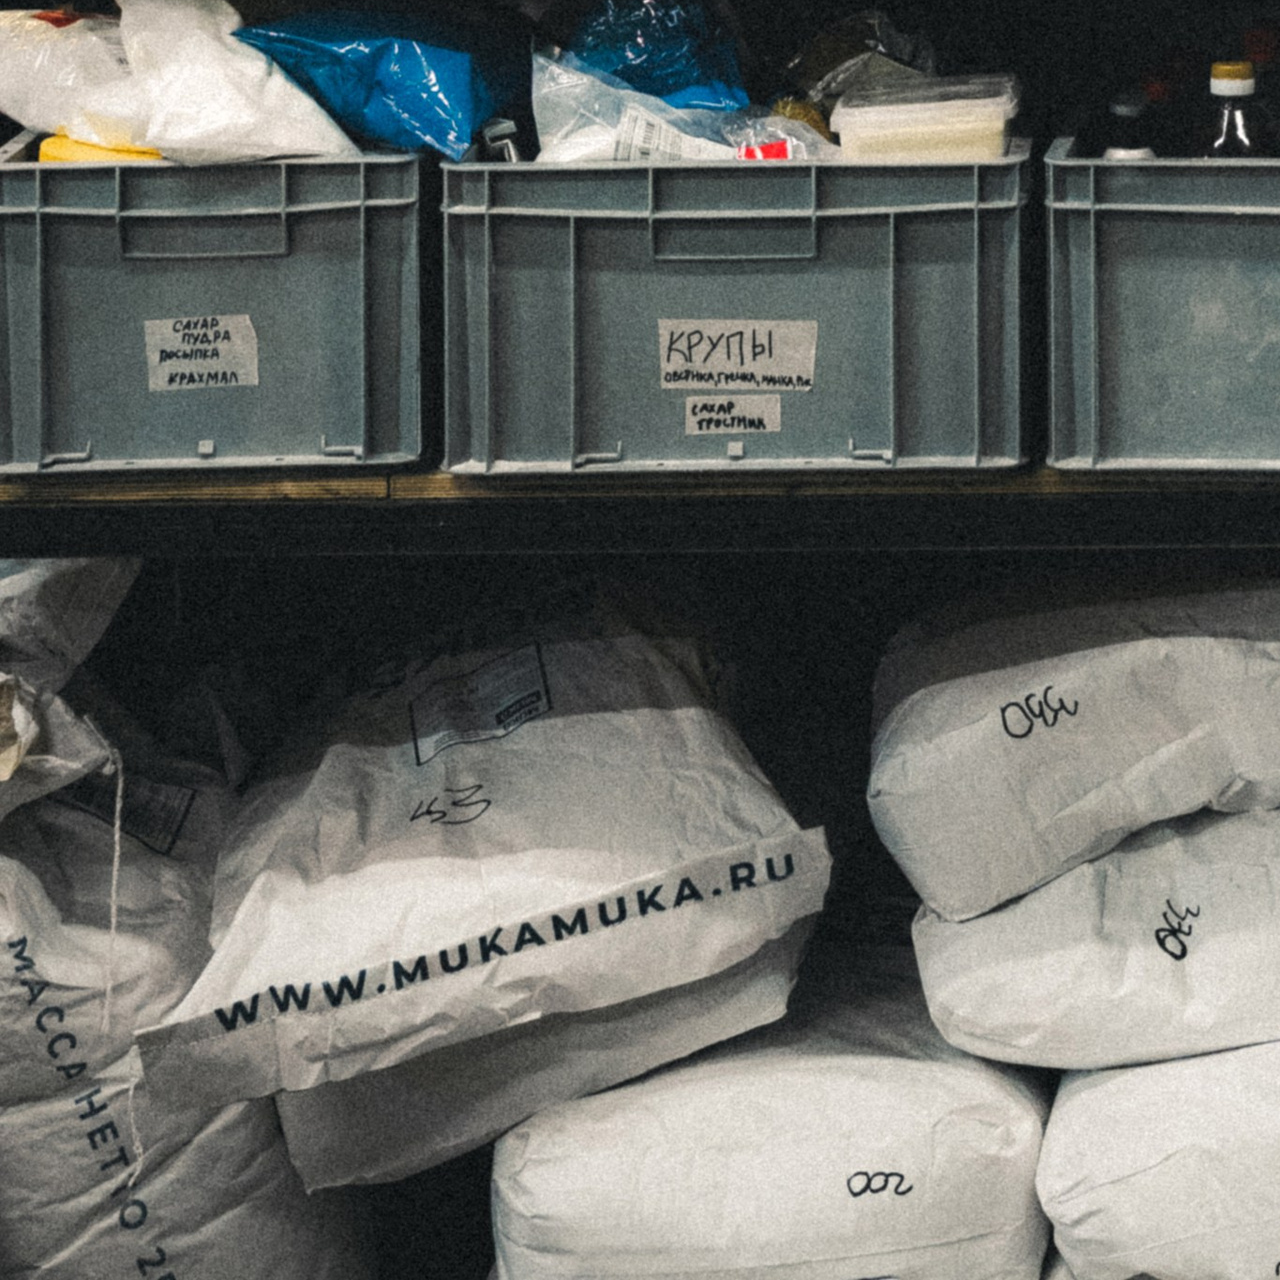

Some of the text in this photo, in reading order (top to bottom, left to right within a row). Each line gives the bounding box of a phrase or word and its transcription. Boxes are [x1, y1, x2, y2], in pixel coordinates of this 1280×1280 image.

[172, 317, 220, 334] САХАР
[182, 330, 232, 346] ПУДРА
[667, 328, 773, 366] КРУПЫ
[168, 371, 239, 386] КРАХМАЛ
[691, 401, 736, 416] САХАР
[214, 852, 796, 1033] WWW.MUKAMUKA.RU
[7, 936, 88, 1081] МАССА
